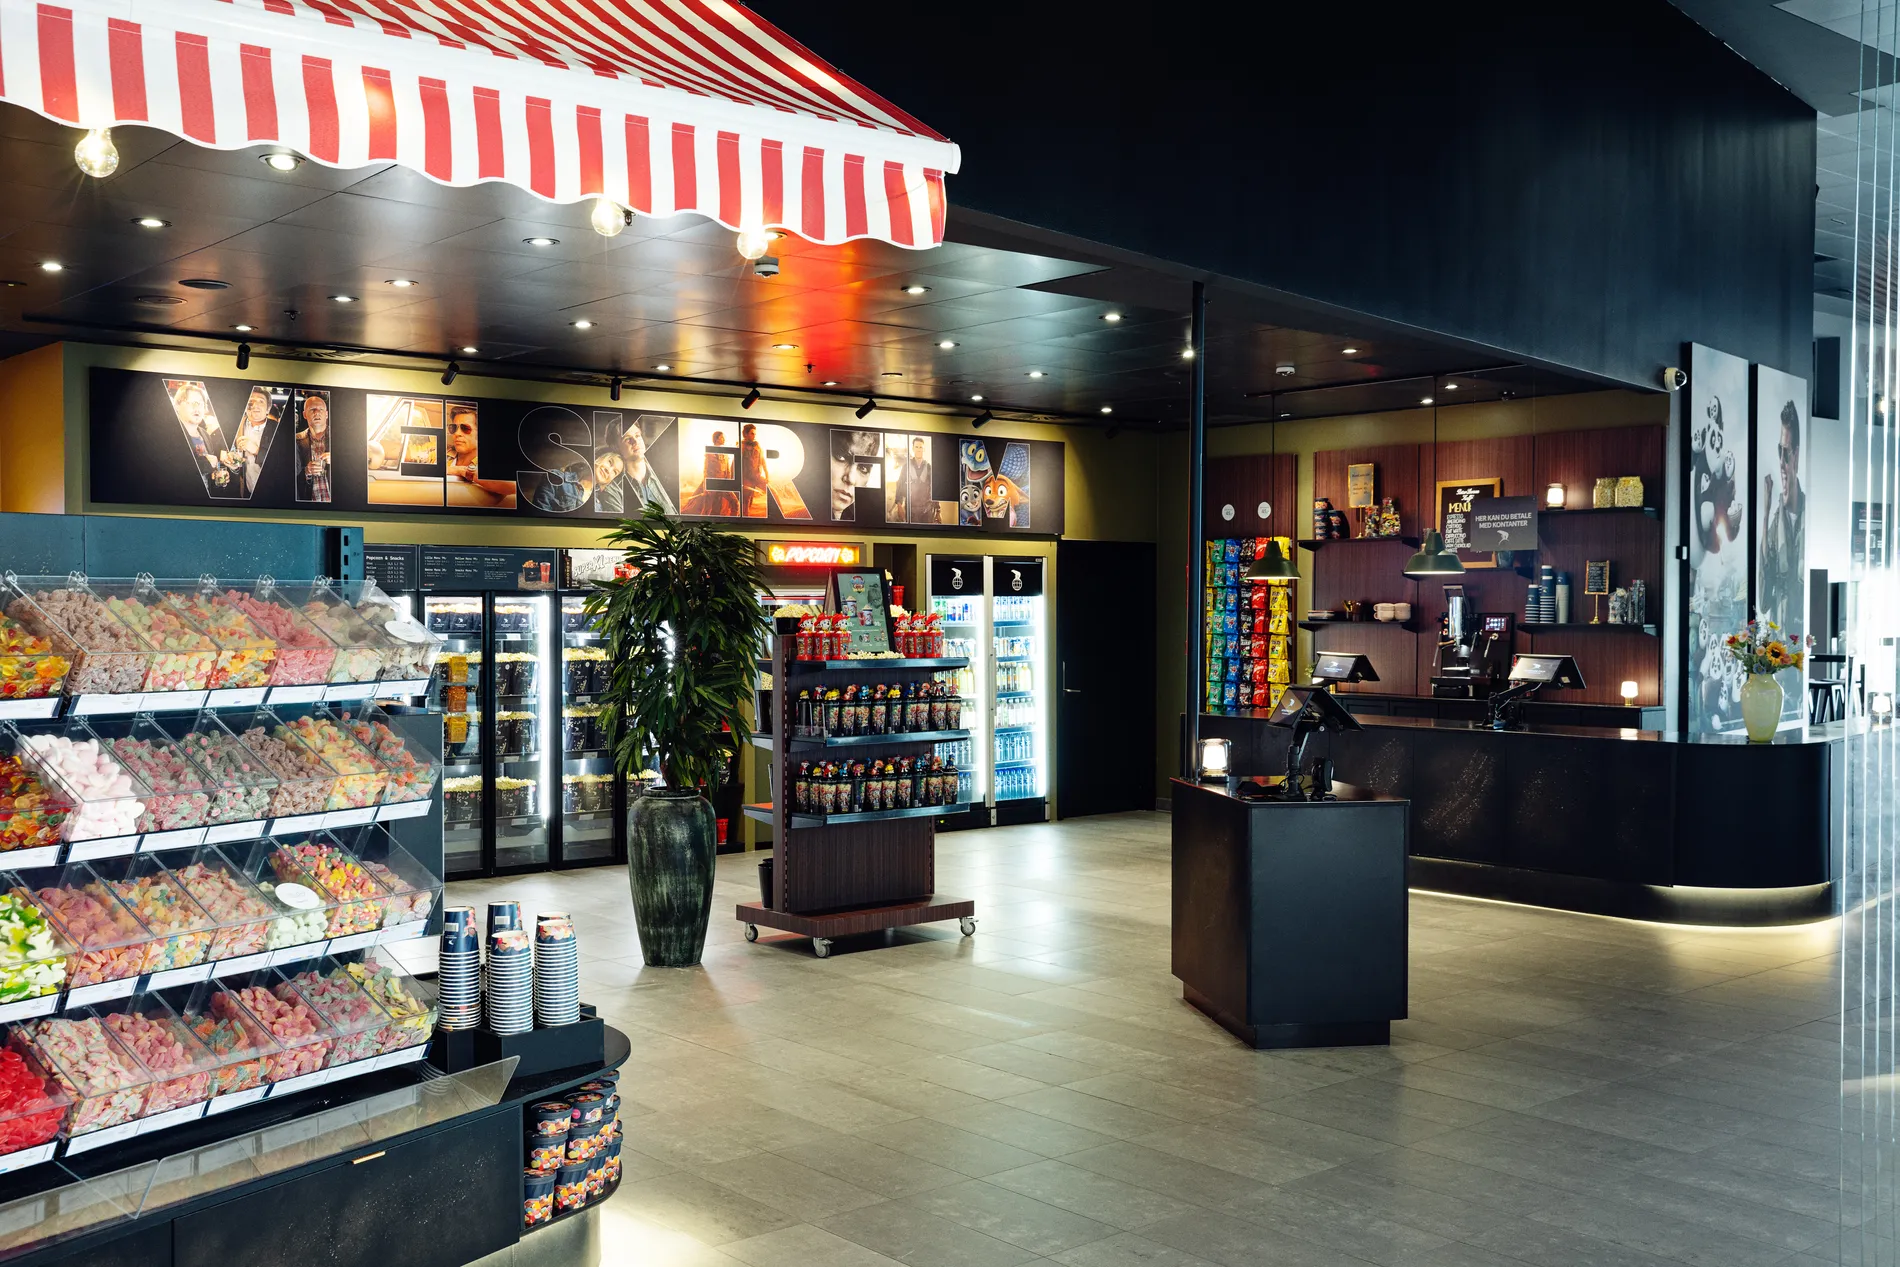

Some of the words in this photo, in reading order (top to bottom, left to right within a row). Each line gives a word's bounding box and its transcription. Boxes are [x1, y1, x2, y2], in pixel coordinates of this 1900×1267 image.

[161, 378, 332, 503] VI
[366, 394, 814, 521] ELSKER
[829, 428, 1031, 528] FILM
[1510, 512, 1532, 520] BETALE
[1492, 520, 1528, 528] KONTANTER
[574, 561, 593, 578] SUPER
